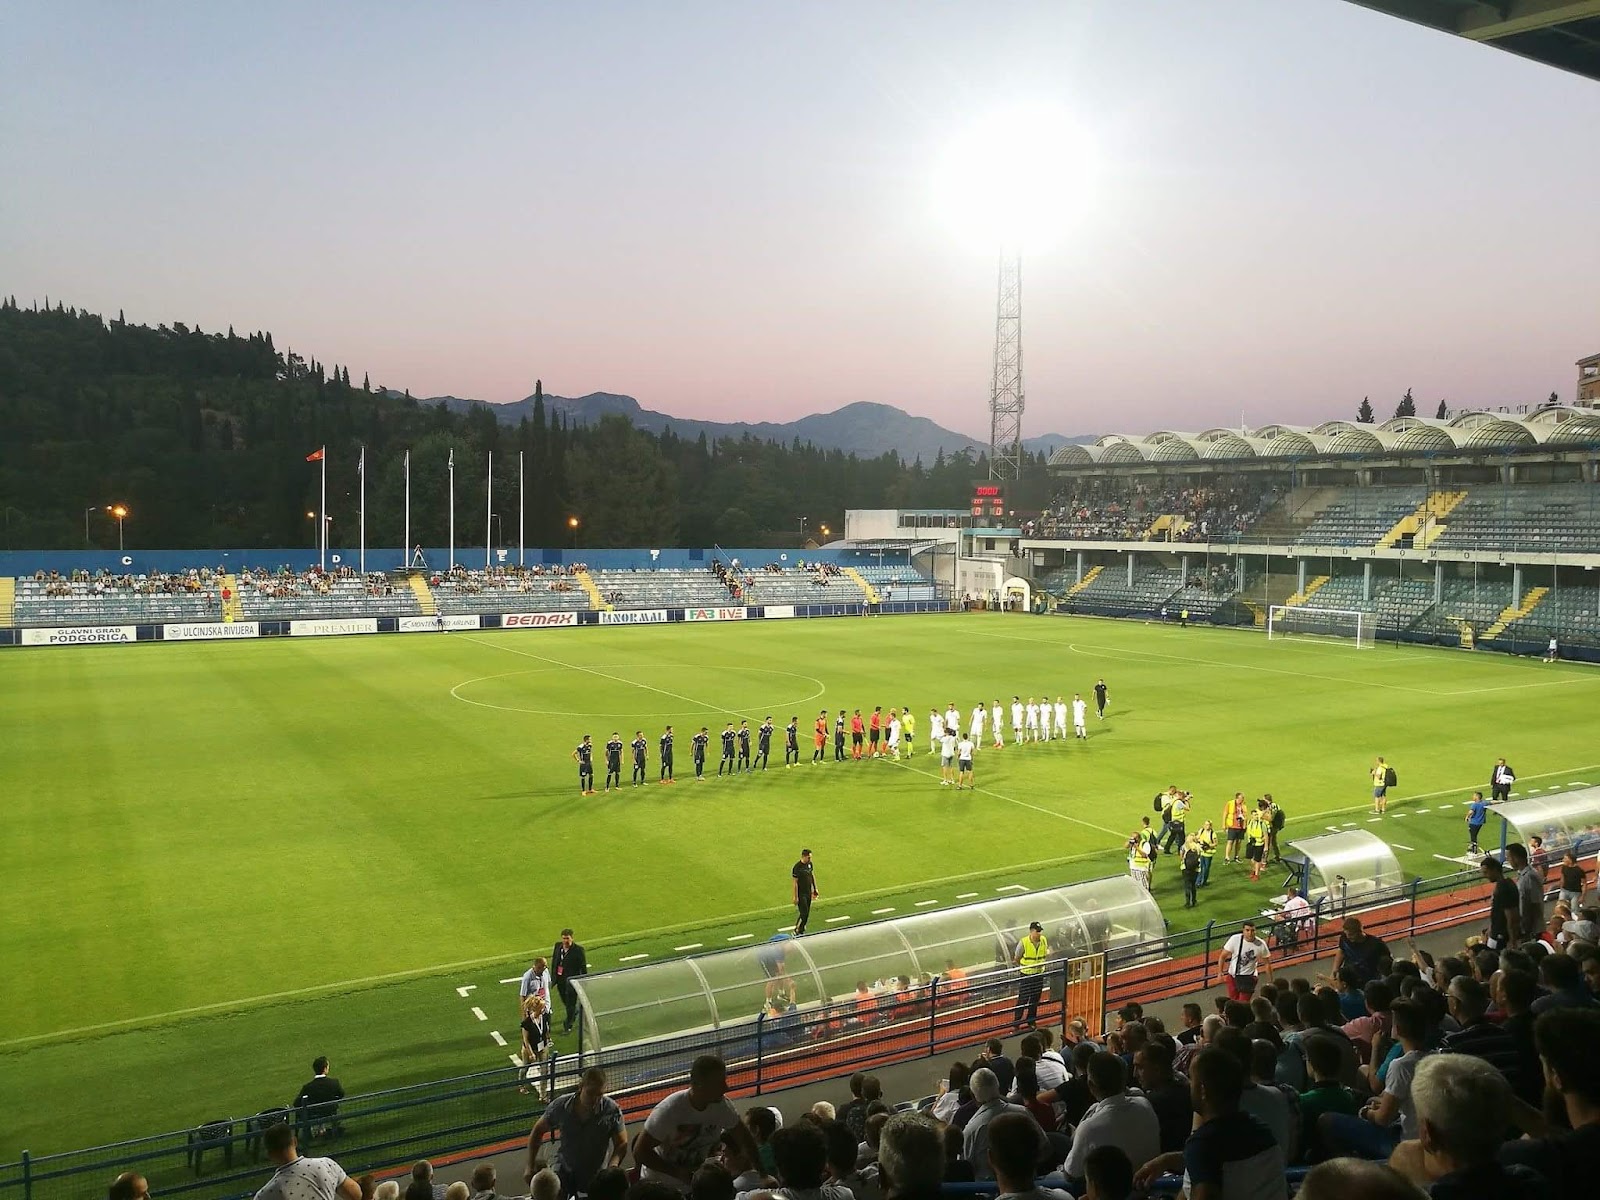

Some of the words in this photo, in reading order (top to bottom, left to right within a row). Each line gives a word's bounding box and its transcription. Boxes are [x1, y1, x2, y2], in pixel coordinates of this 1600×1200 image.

[122, 556, 132, 565] C
[332, 555, 341, 563] D
[506, 614, 573, 625] BEMAX
[183, 627, 222, 637] ULCINJSKA
[224, 625, 254, 635] RIVIJERA
[314, 624, 373, 633] PREMIER
[49, 633, 128, 643] PODGORICA
